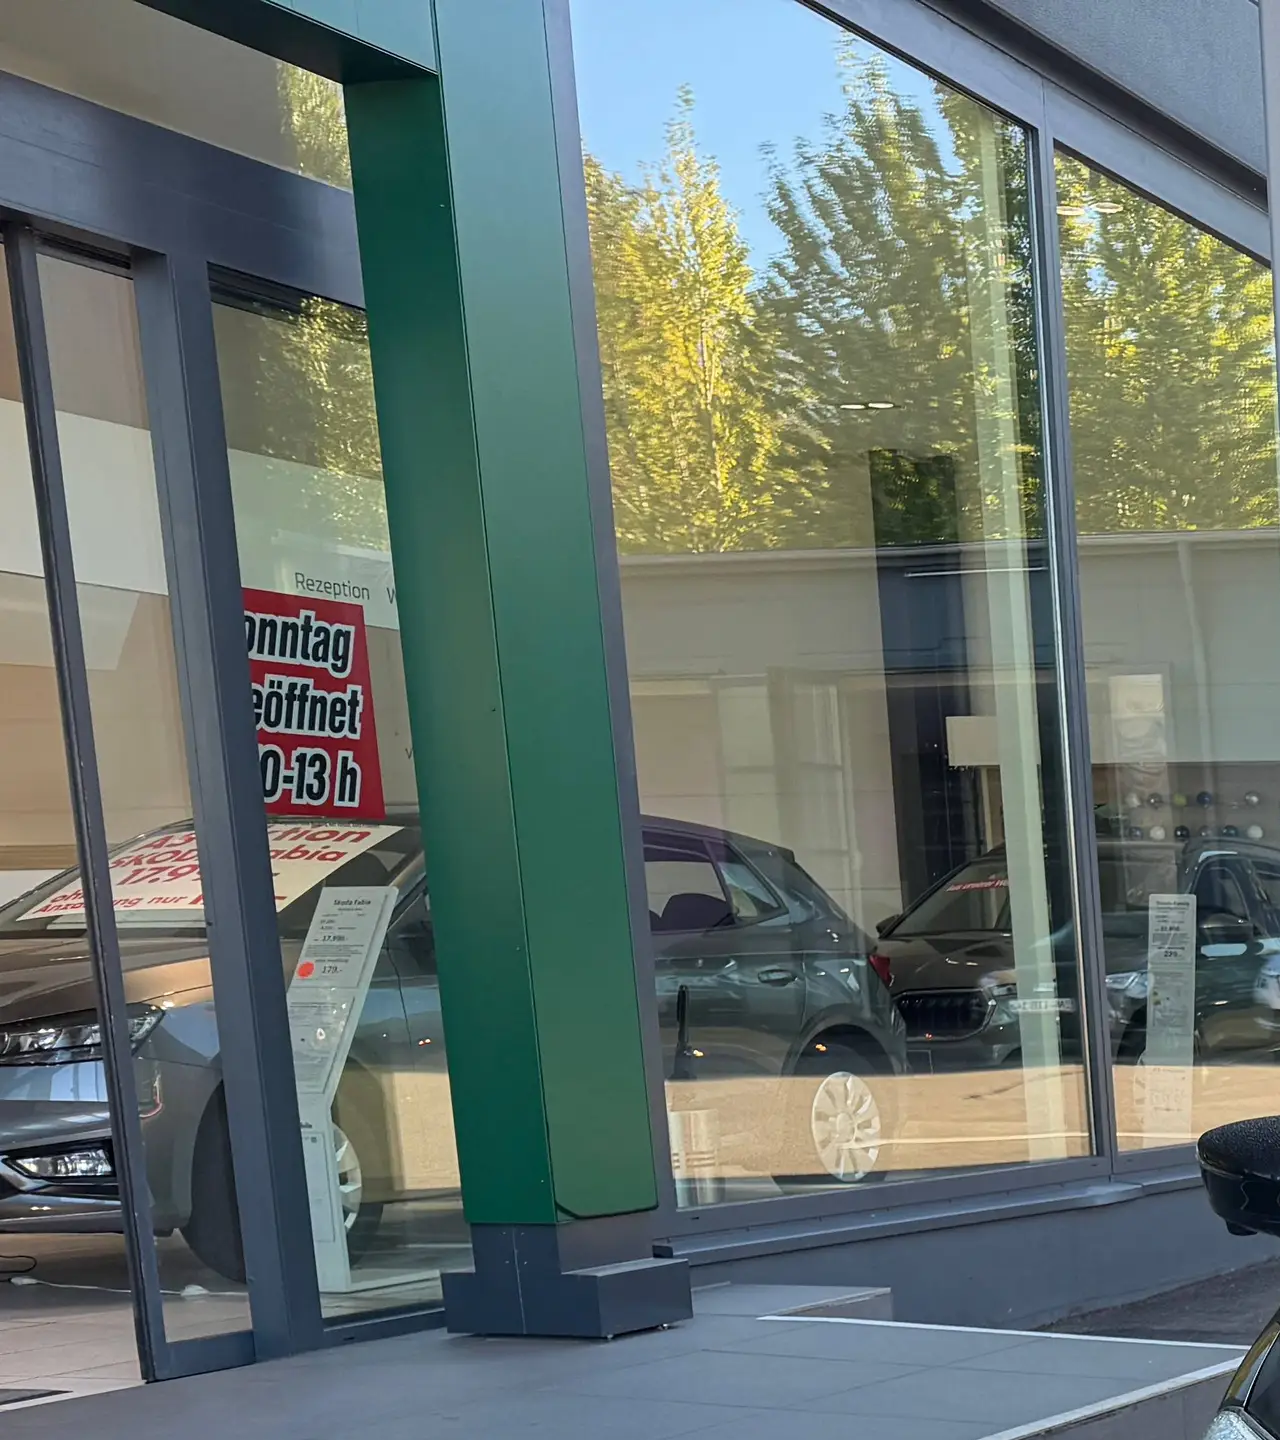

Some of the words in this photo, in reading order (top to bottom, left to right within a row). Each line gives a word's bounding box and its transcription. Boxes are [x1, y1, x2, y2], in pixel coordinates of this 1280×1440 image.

[294, 572, 370, 600] Rezeption
[244, 613, 353, 674] onntag
[252, 679, 362, 736] eöffnet
[260, 749, 328, 801] 0-13
[339, 755, 358, 803] h
[109, 849, 200, 869] SKOD
[269, 845, 348, 861] abia
[149, 896, 189, 905] nur
